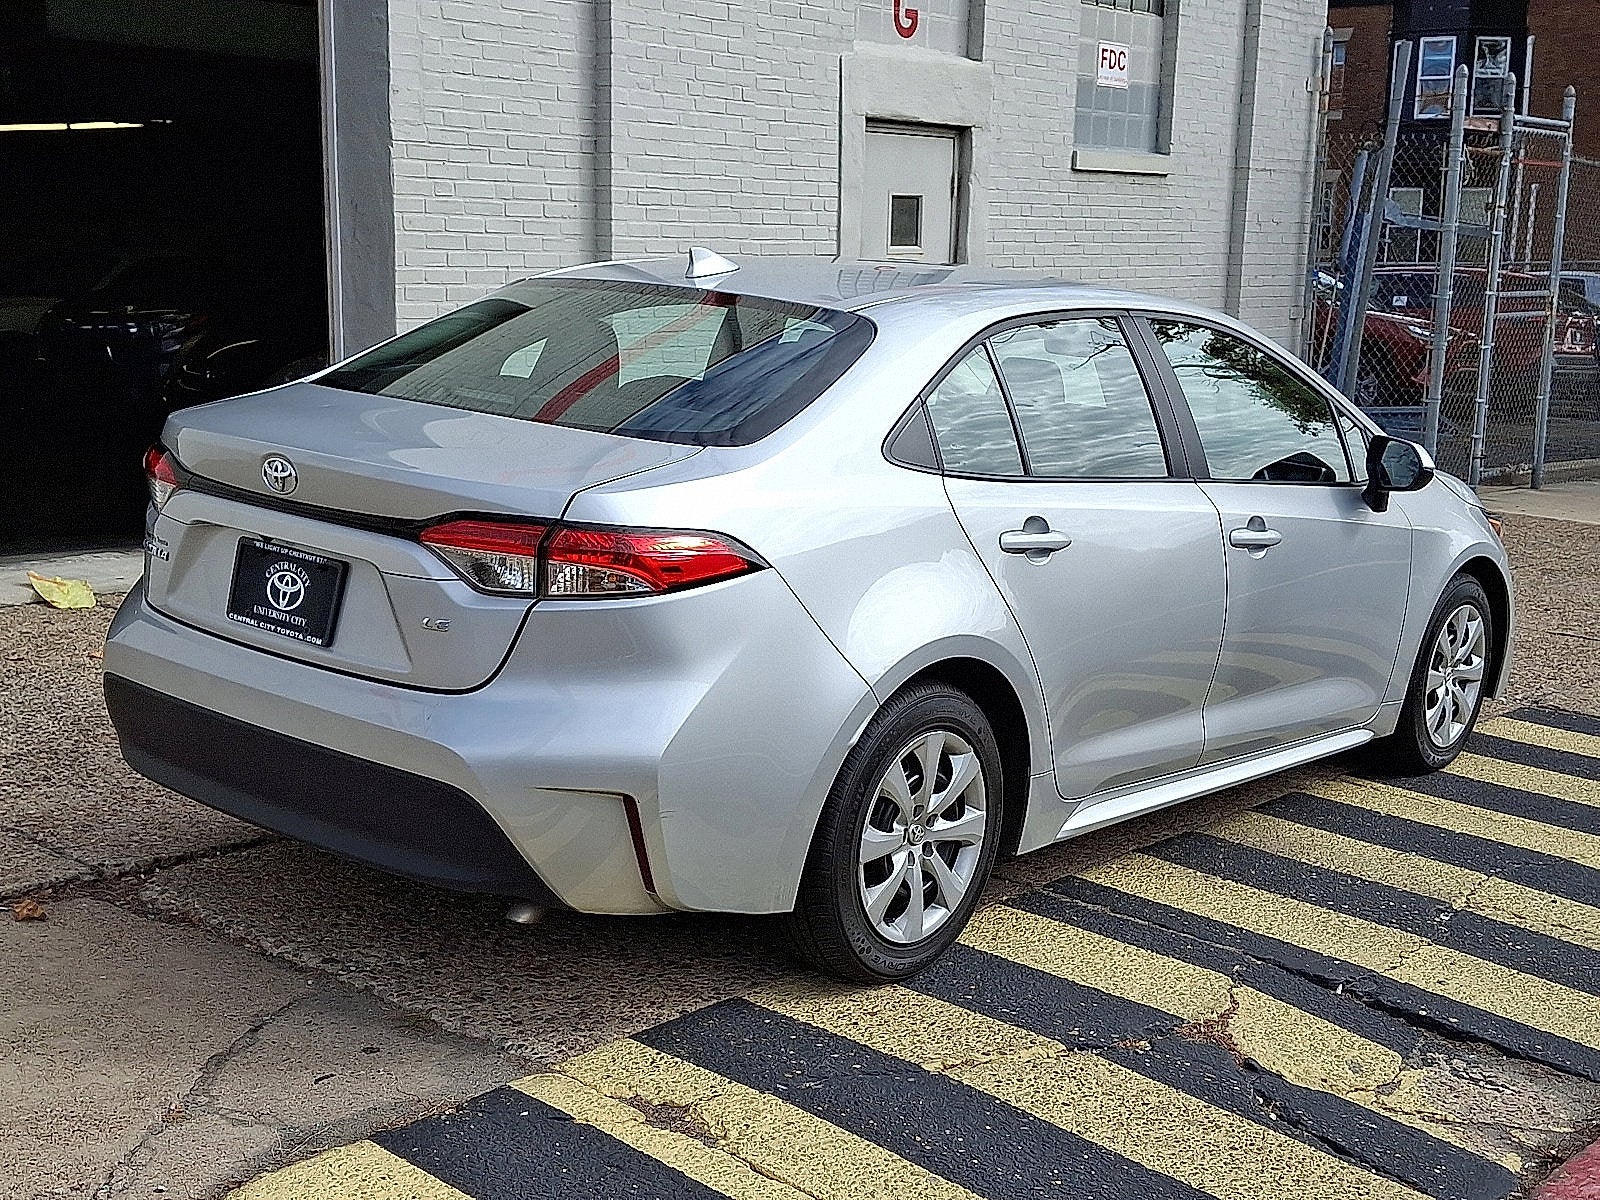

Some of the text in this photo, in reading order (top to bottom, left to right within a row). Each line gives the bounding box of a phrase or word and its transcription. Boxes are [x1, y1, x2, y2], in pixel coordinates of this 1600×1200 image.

[1101, 48, 1126, 71] FDC
[265, 561, 311, 587] CENTRAL CITY
[229, 613, 258, 627] CENTRAL
[260, 621, 275, 632] CITY
[253, 604, 307, 627] UNIVERSITY CITY
[421, 616, 452, 632] LE
